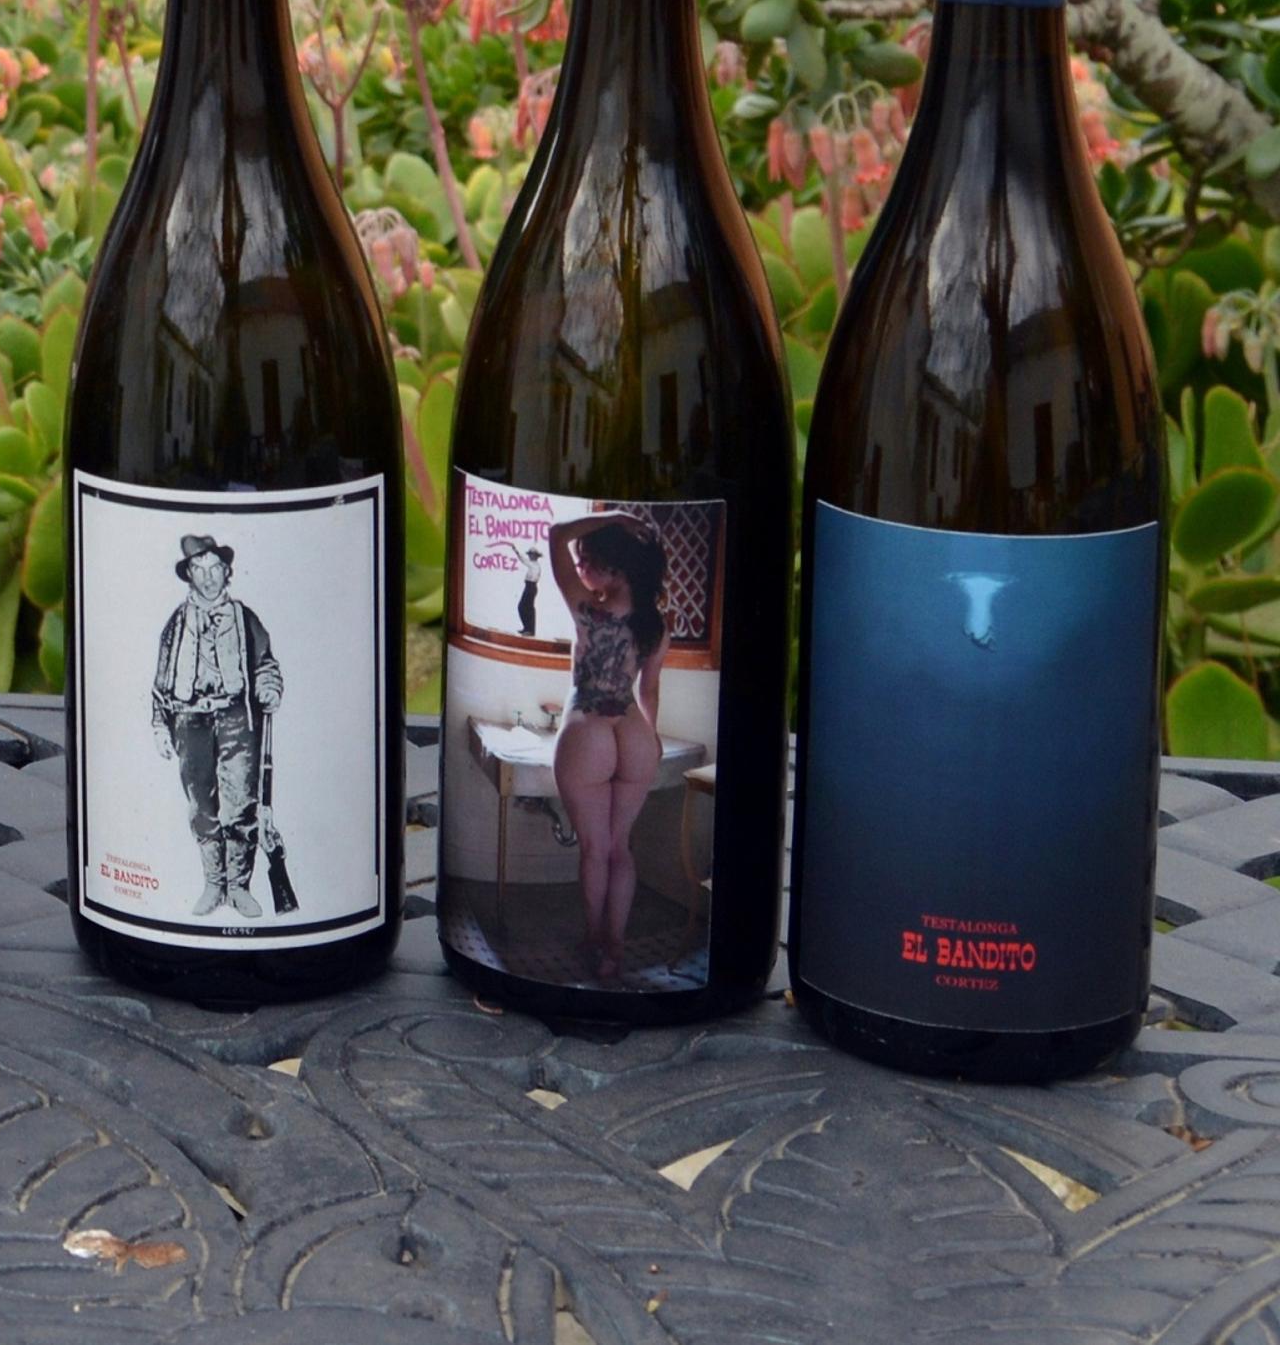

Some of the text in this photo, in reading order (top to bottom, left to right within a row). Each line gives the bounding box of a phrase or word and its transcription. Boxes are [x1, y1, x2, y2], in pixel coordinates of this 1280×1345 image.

[465, 485, 554, 518] TESTALONGA
[468, 514, 483, 536] EL
[473, 552, 519, 571] CORTEZ
[101, 863, 159, 890] EL BANDITO
[921, 914, 1019, 935] TESTALONGA
[901, 931, 1037, 972] EL BANDITO
[935, 974, 1000, 991] CORTEZ
